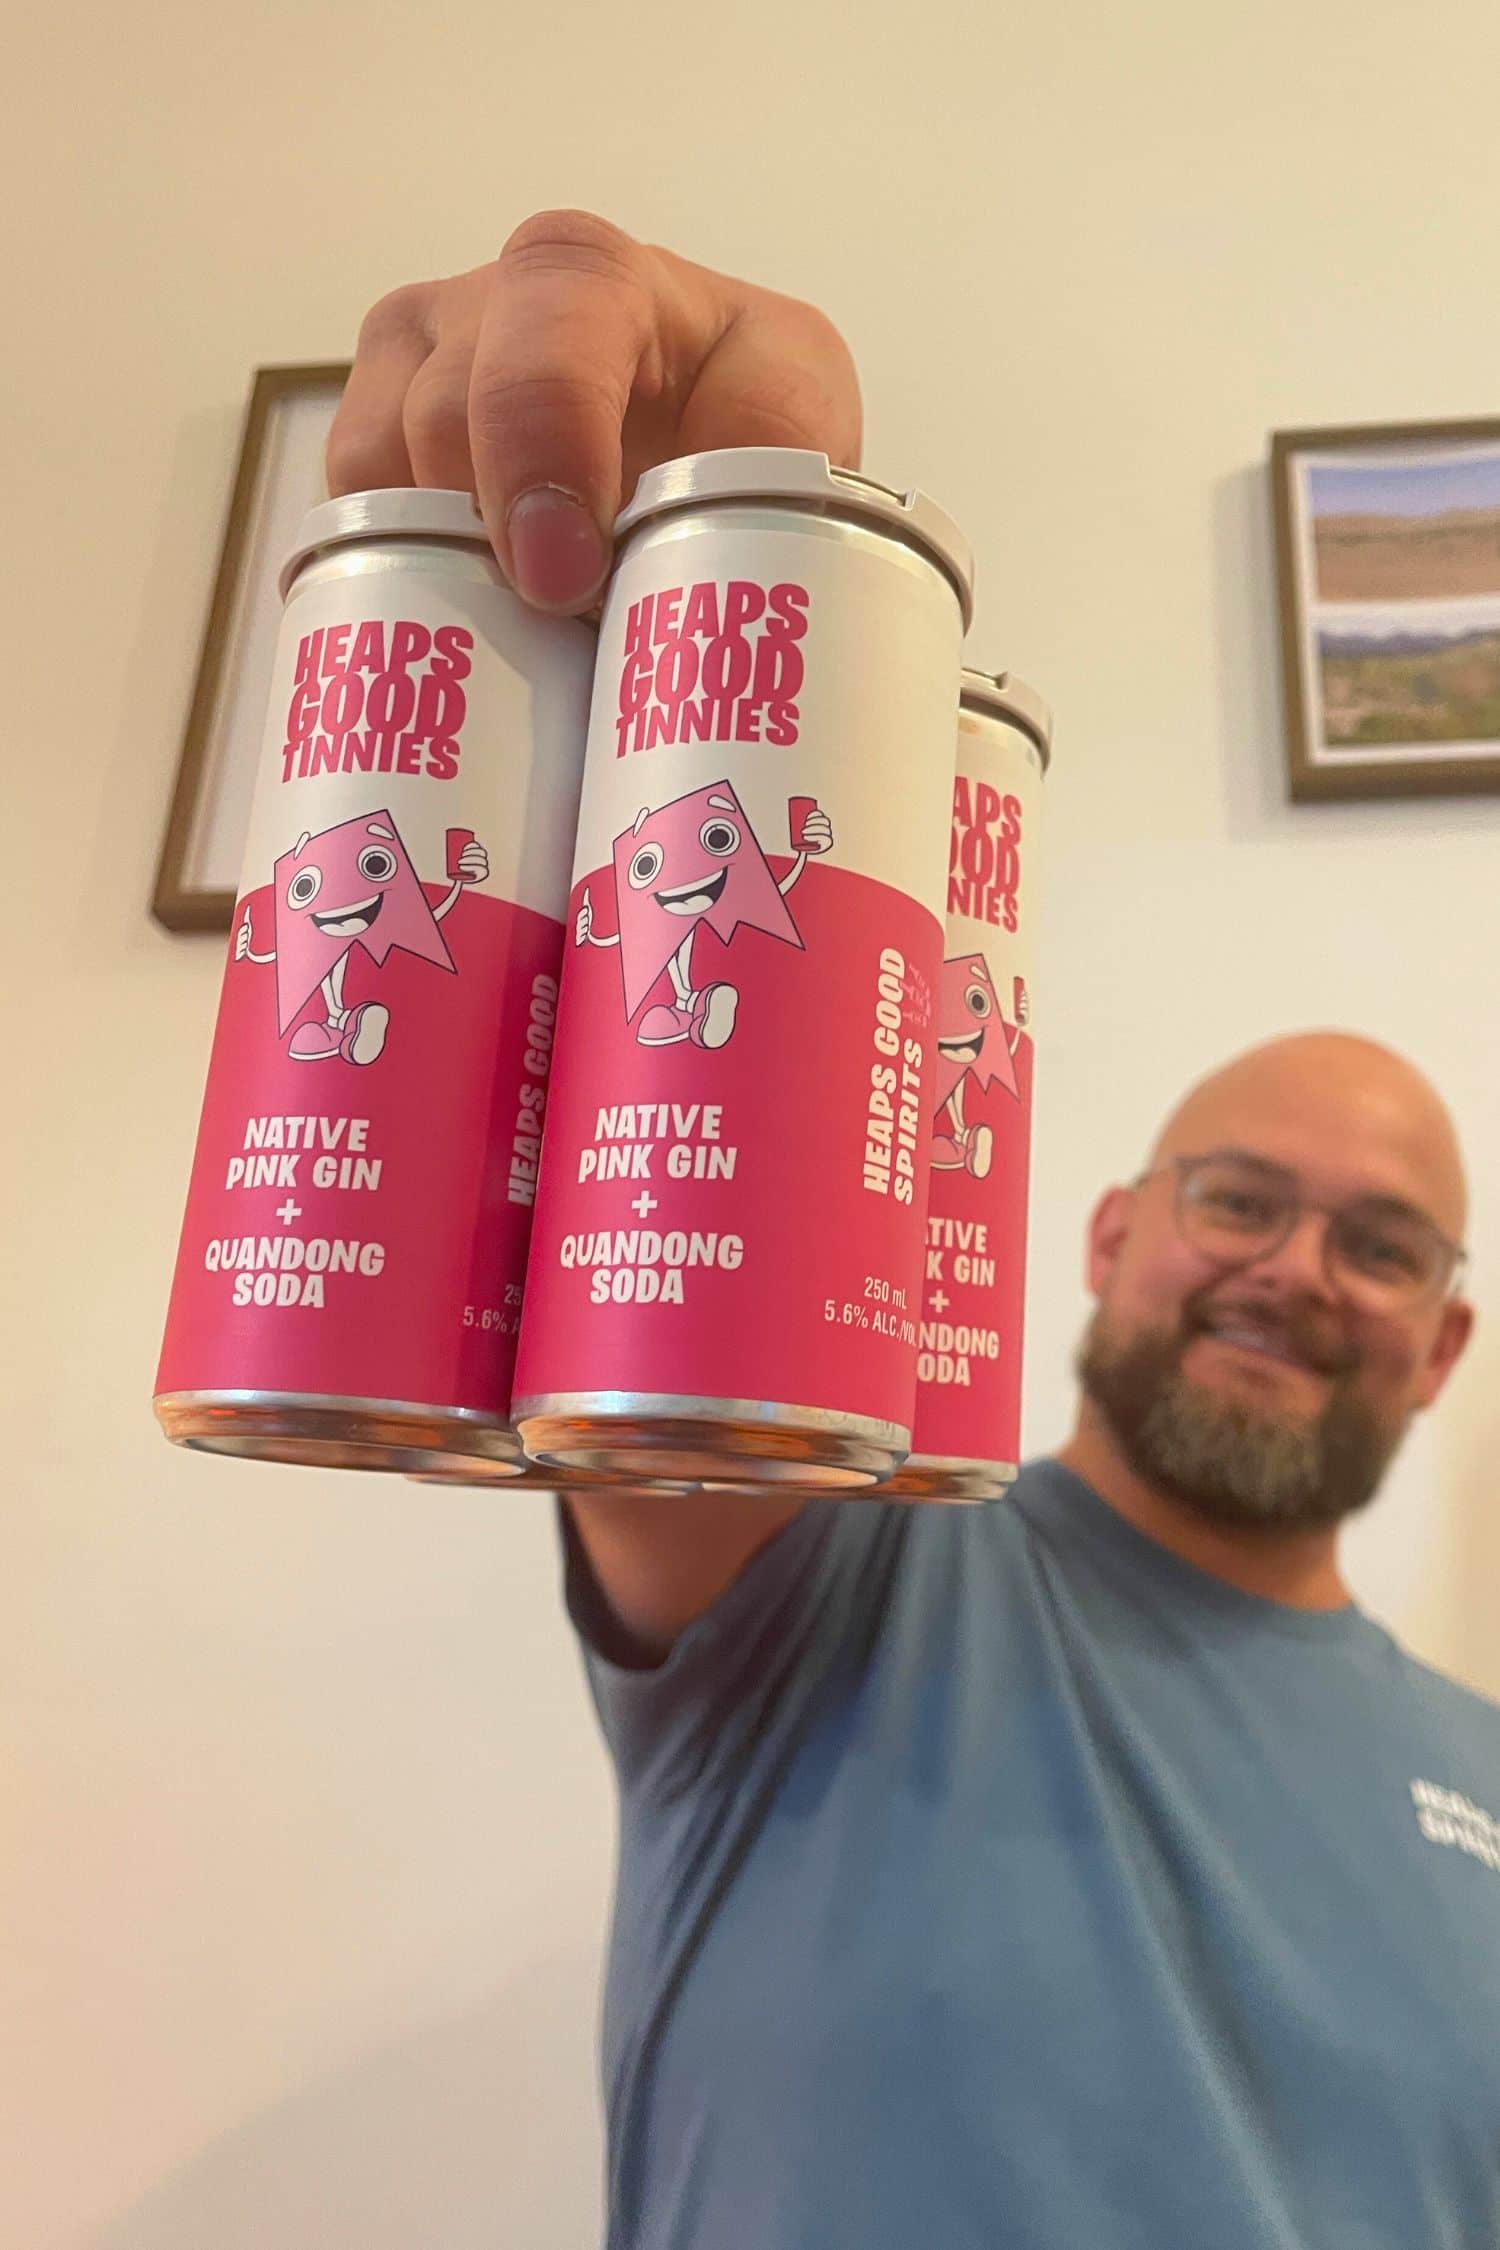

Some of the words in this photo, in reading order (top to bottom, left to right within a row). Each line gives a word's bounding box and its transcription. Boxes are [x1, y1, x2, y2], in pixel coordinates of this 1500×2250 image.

[624, 581, 810, 657] HEAPS
[294, 621, 474, 686] HEAPS
[619, 636, 805, 715] GOOD
[287, 671, 467, 742] GOOD
[616, 698, 799, 759] TINNIES
[282, 732, 460, 783] TINNIES
[952, 776, 1022, 846] APS
[949, 826, 1020, 897] OD
[947, 876, 1018, 933] NIES
[874, 947, 905, 1056] GOOD
[523, 974, 558, 1077] GOOD
[243, 1116, 370, 1152] NATIVE
[595, 1104, 723, 1141] NATIVE
[863, 1063, 897, 1195] HEAPS
[894, 1038, 922, 1205] SPIRITS
[508, 1083, 545, 1207] HEAPS
[578, 1144, 654, 1183] PINK
[667, 1144, 737, 1180] GIN
[225, 1155, 301, 1190] PINK
[312, 1156, 383, 1191] GIN
[275, 1198, 302, 1225] +
[631, 1190, 658, 1218] +
[560, 1231, 744, 1270] QUANDONG
[926, 1217, 988, 1253] TIVE
[205, 1236, 385, 1276] QUANDONG
[953, 1254, 996, 1288] GIN
[232, 1273, 325, 1308] SODA
[504, 1284, 522, 1306] 25
[590, 1268, 685, 1305] SODA
[864, 1276, 890, 1303] 250
[892, 1288, 907, 1310] mL
[463, 1306, 507, 1332] 5.6%
[824, 1299, 869, 1329] 5.6%
[918, 1322, 999, 1359] NDONG
[917, 1353, 971, 1387] ODA
